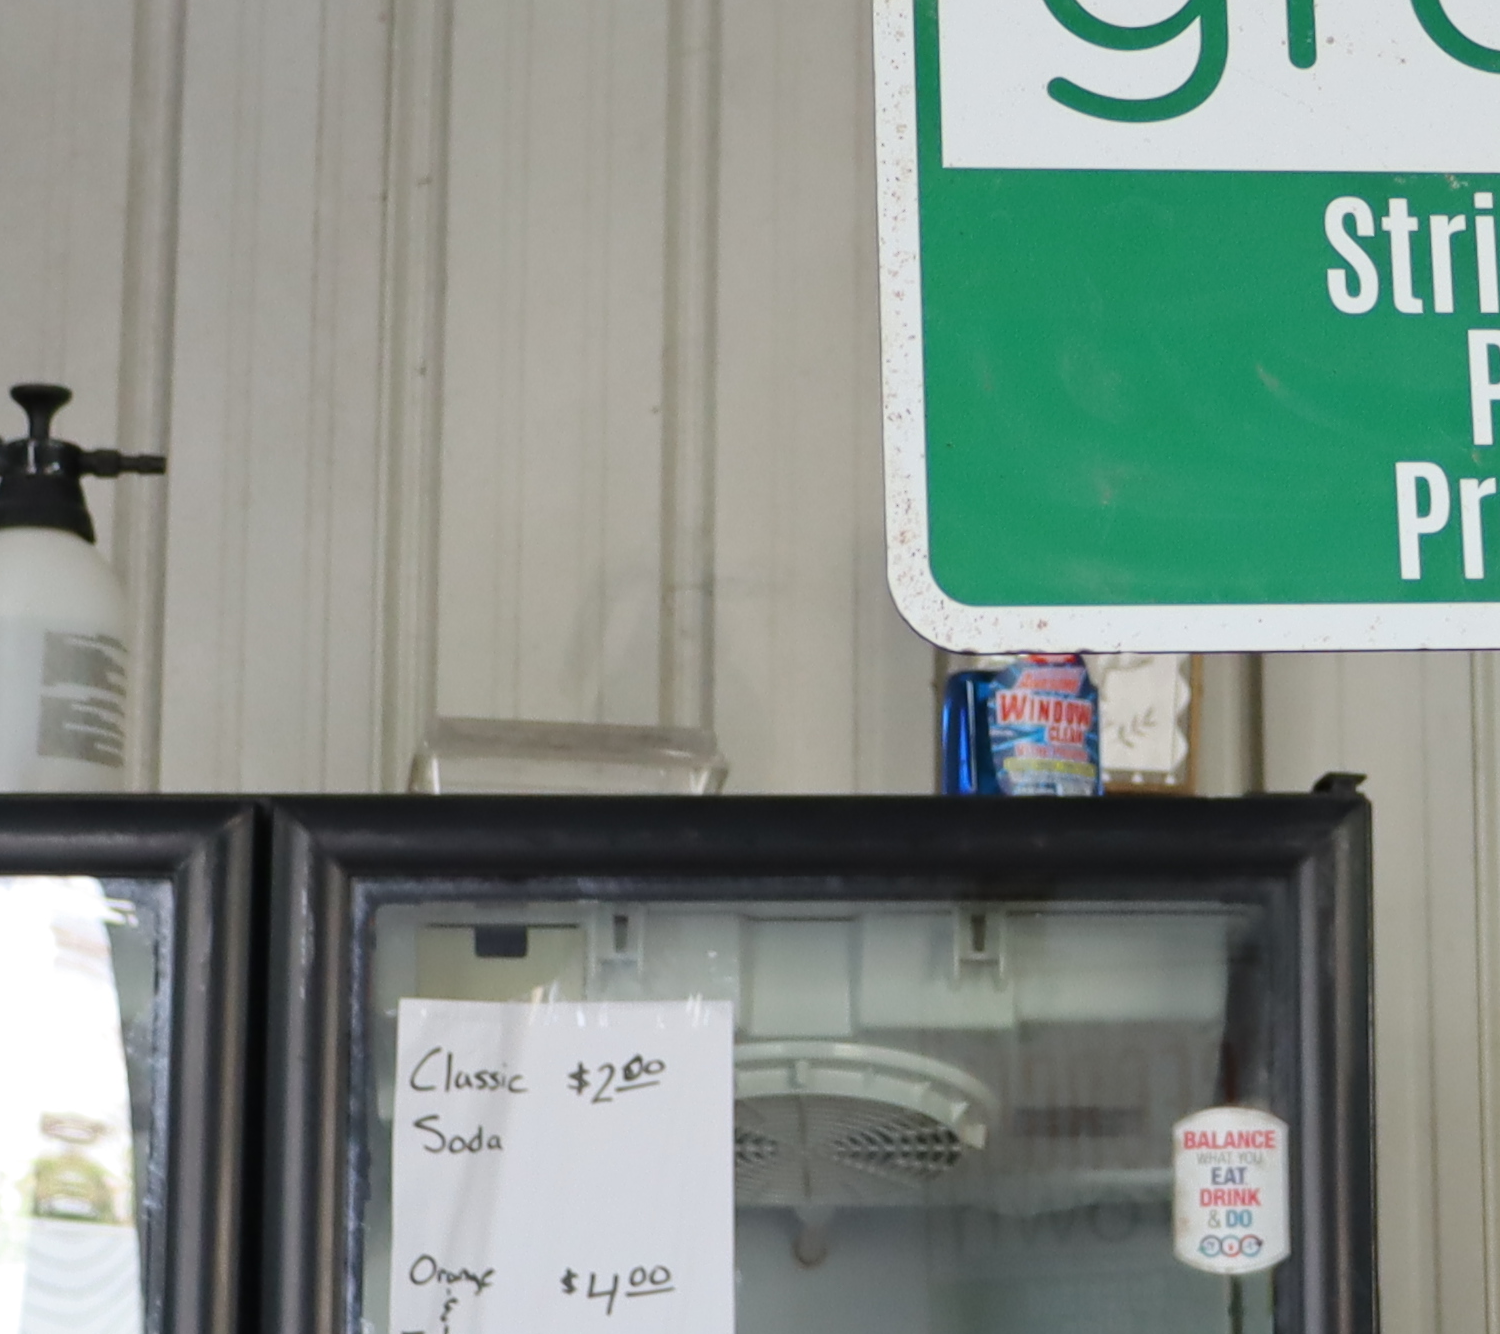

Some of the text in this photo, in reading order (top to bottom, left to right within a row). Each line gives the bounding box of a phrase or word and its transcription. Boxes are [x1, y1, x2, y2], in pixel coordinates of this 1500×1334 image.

[409, 1047, 529, 1094] Classic
[413, 1114, 503, 1154] Soda
[1183, 1129, 1277, 1150] BALANCE
[1197, 1151, 1264, 1165] WHAT YOU
[1199, 1188, 1261, 1208] DRINK
[1207, 1209, 1252, 1229] & DO
